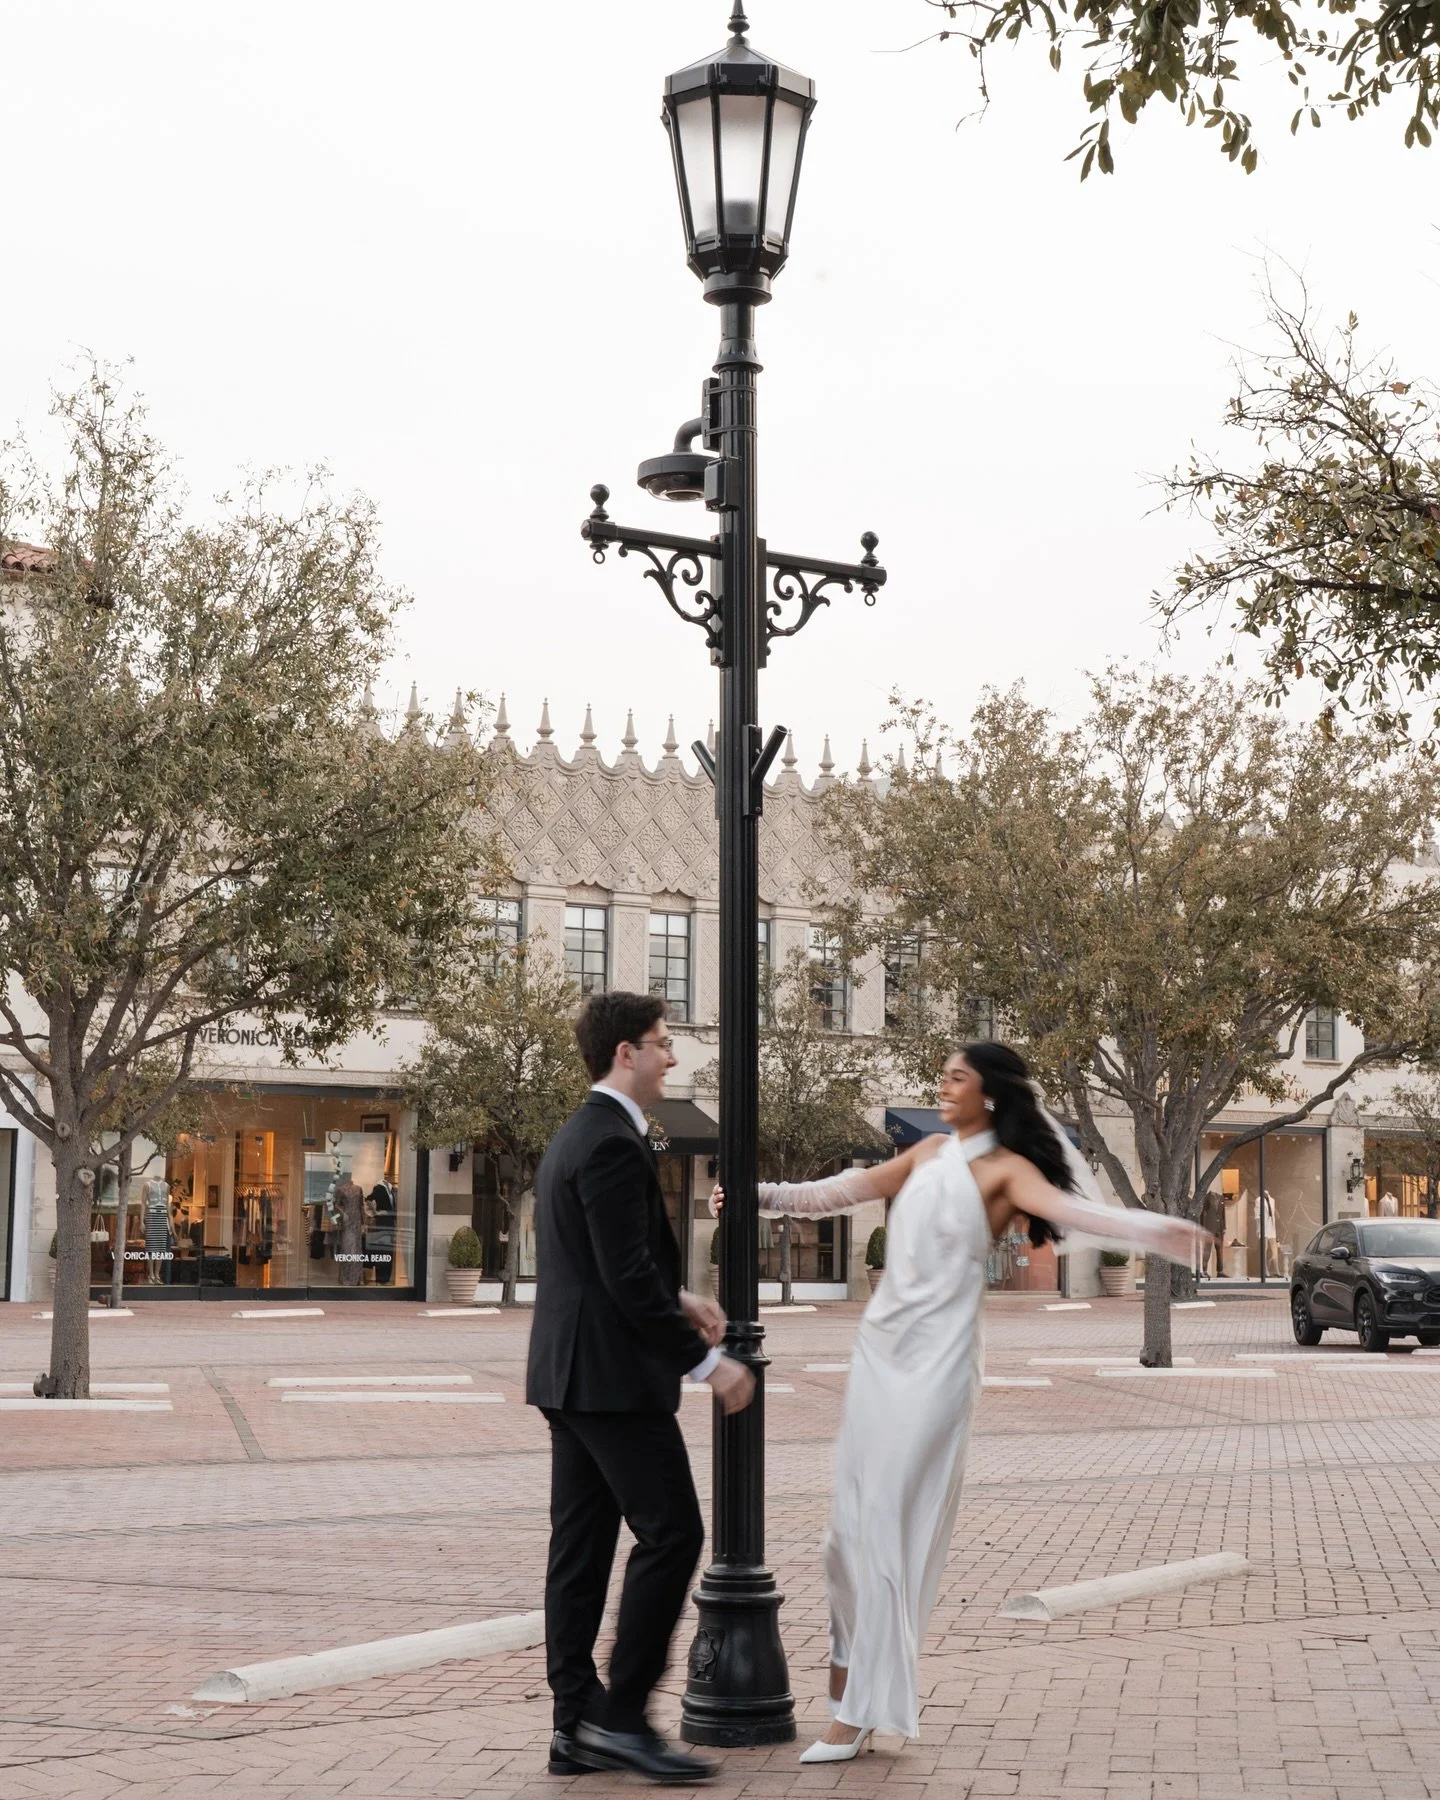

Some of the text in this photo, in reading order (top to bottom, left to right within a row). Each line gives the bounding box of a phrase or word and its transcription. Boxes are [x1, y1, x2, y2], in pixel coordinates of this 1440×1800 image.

[200, 1027, 279, 1047] VERONICA
[111, 1251, 174, 1260] VONICA BEARD
[334, 1253, 392, 1262] VERONICA BEARD
